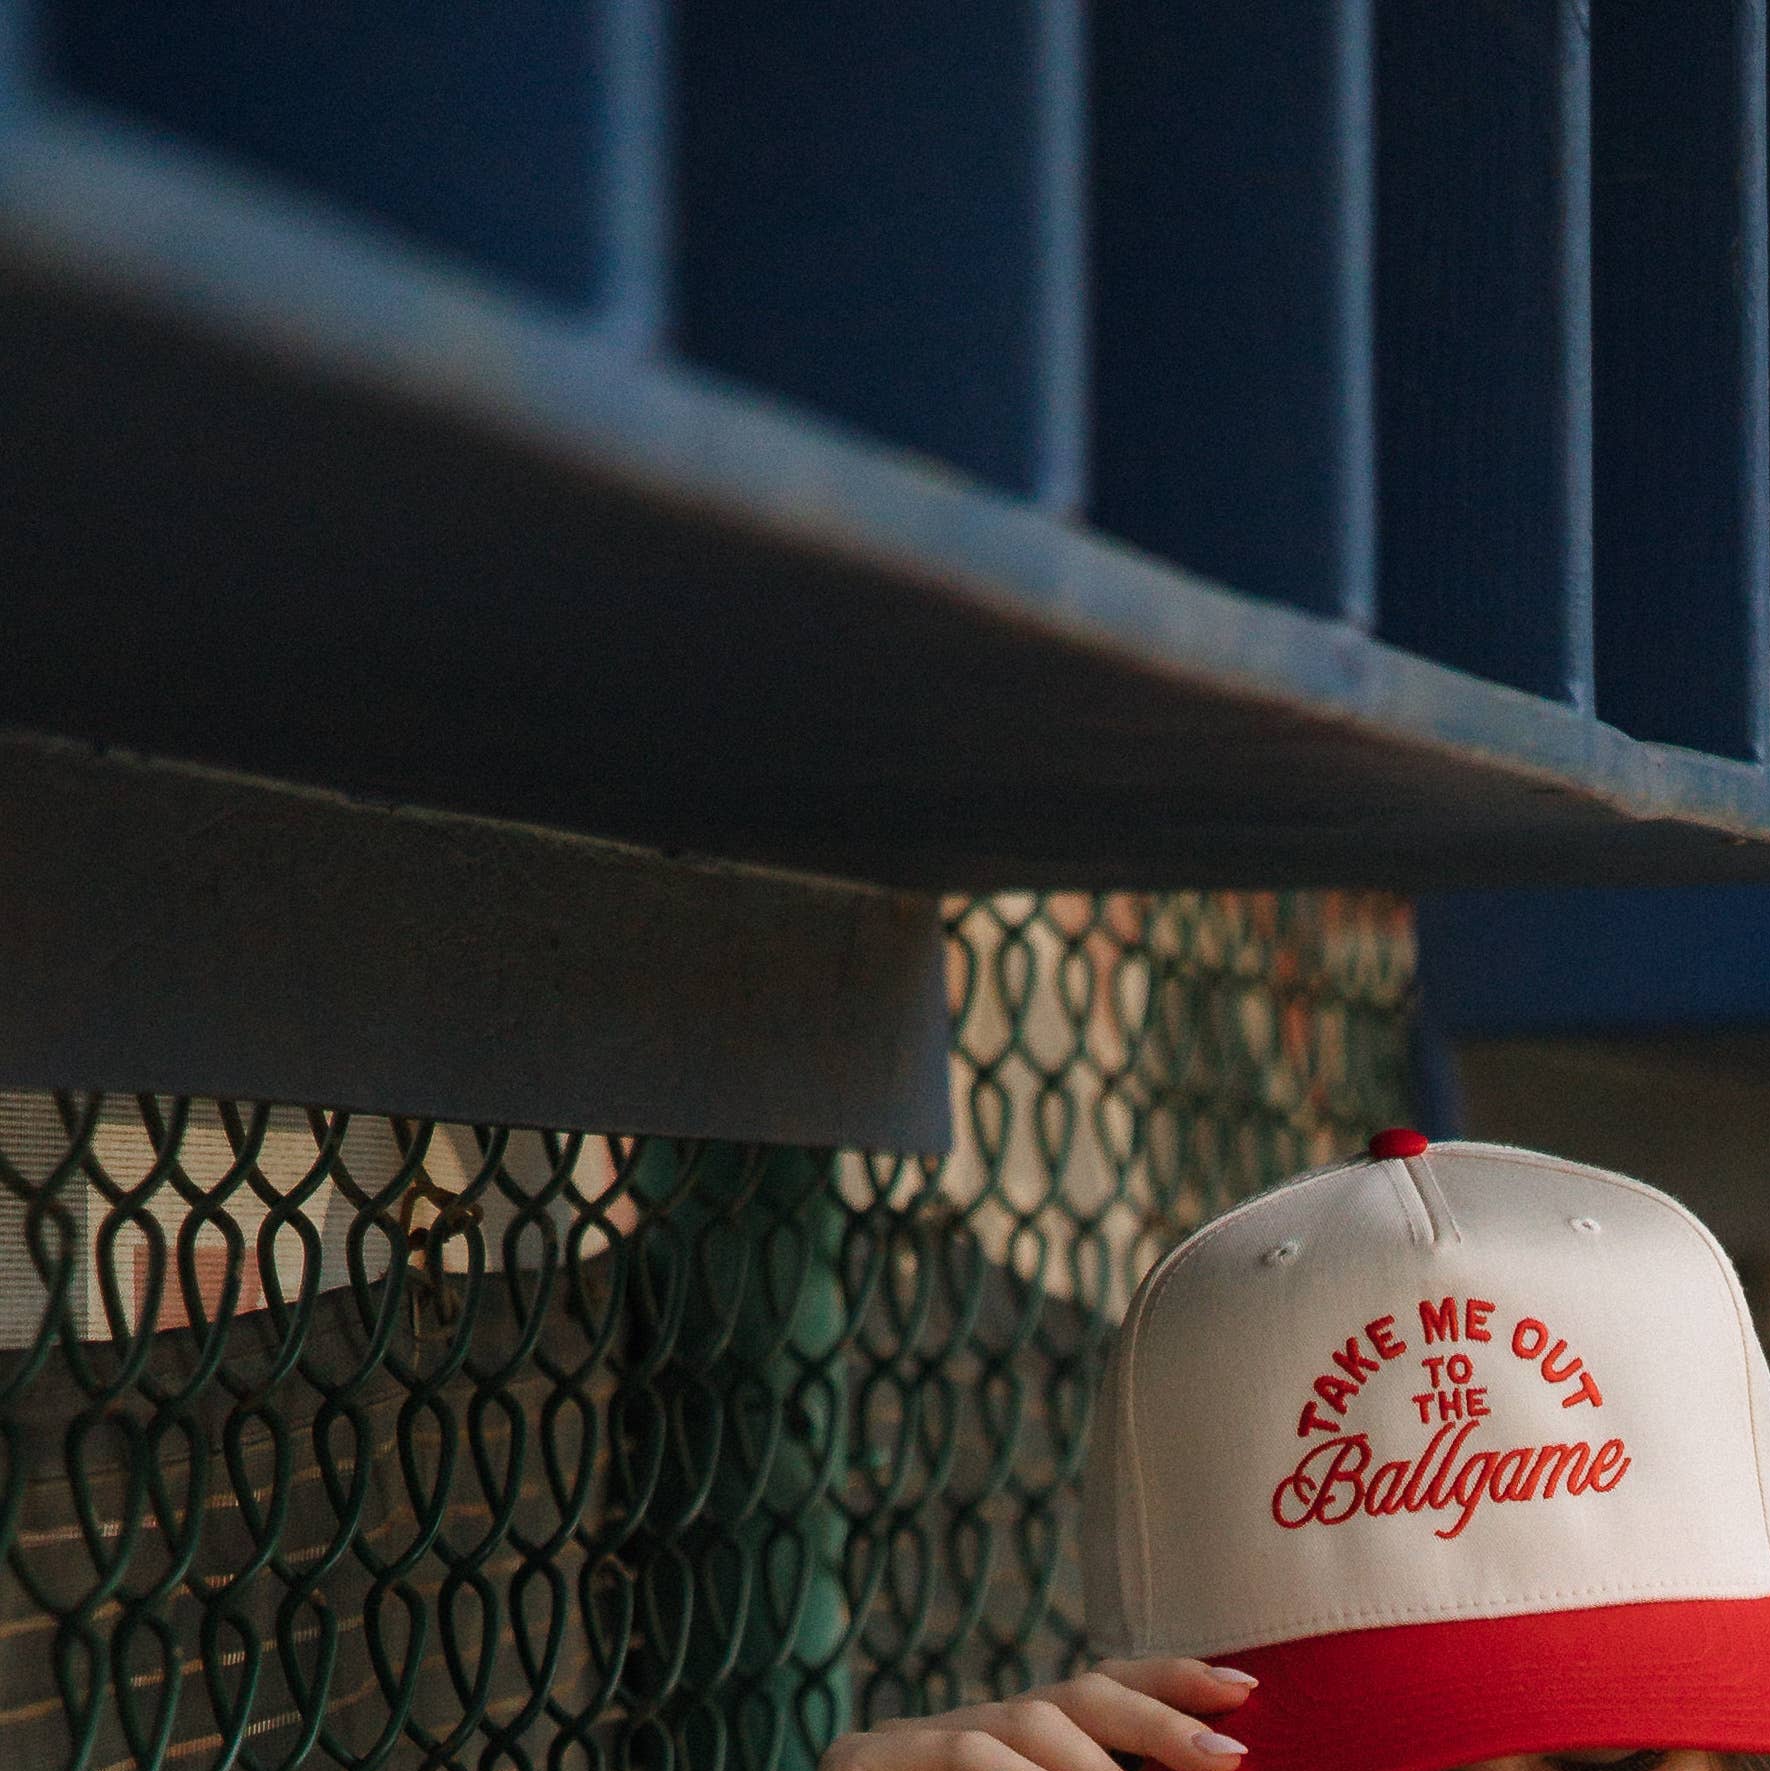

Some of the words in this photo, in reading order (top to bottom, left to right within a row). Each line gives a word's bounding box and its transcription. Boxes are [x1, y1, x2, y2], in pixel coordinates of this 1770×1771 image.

[1297, 1315, 1407, 1437] TAKE
[1418, 1297, 1496, 1344] ME
[1511, 1317, 1603, 1408] OUT
[1411, 1386, 1491, 1424] THE
[1421, 1353, 1474, 1388] TO
[1271, 1420, 1632, 1540] Ballgame
